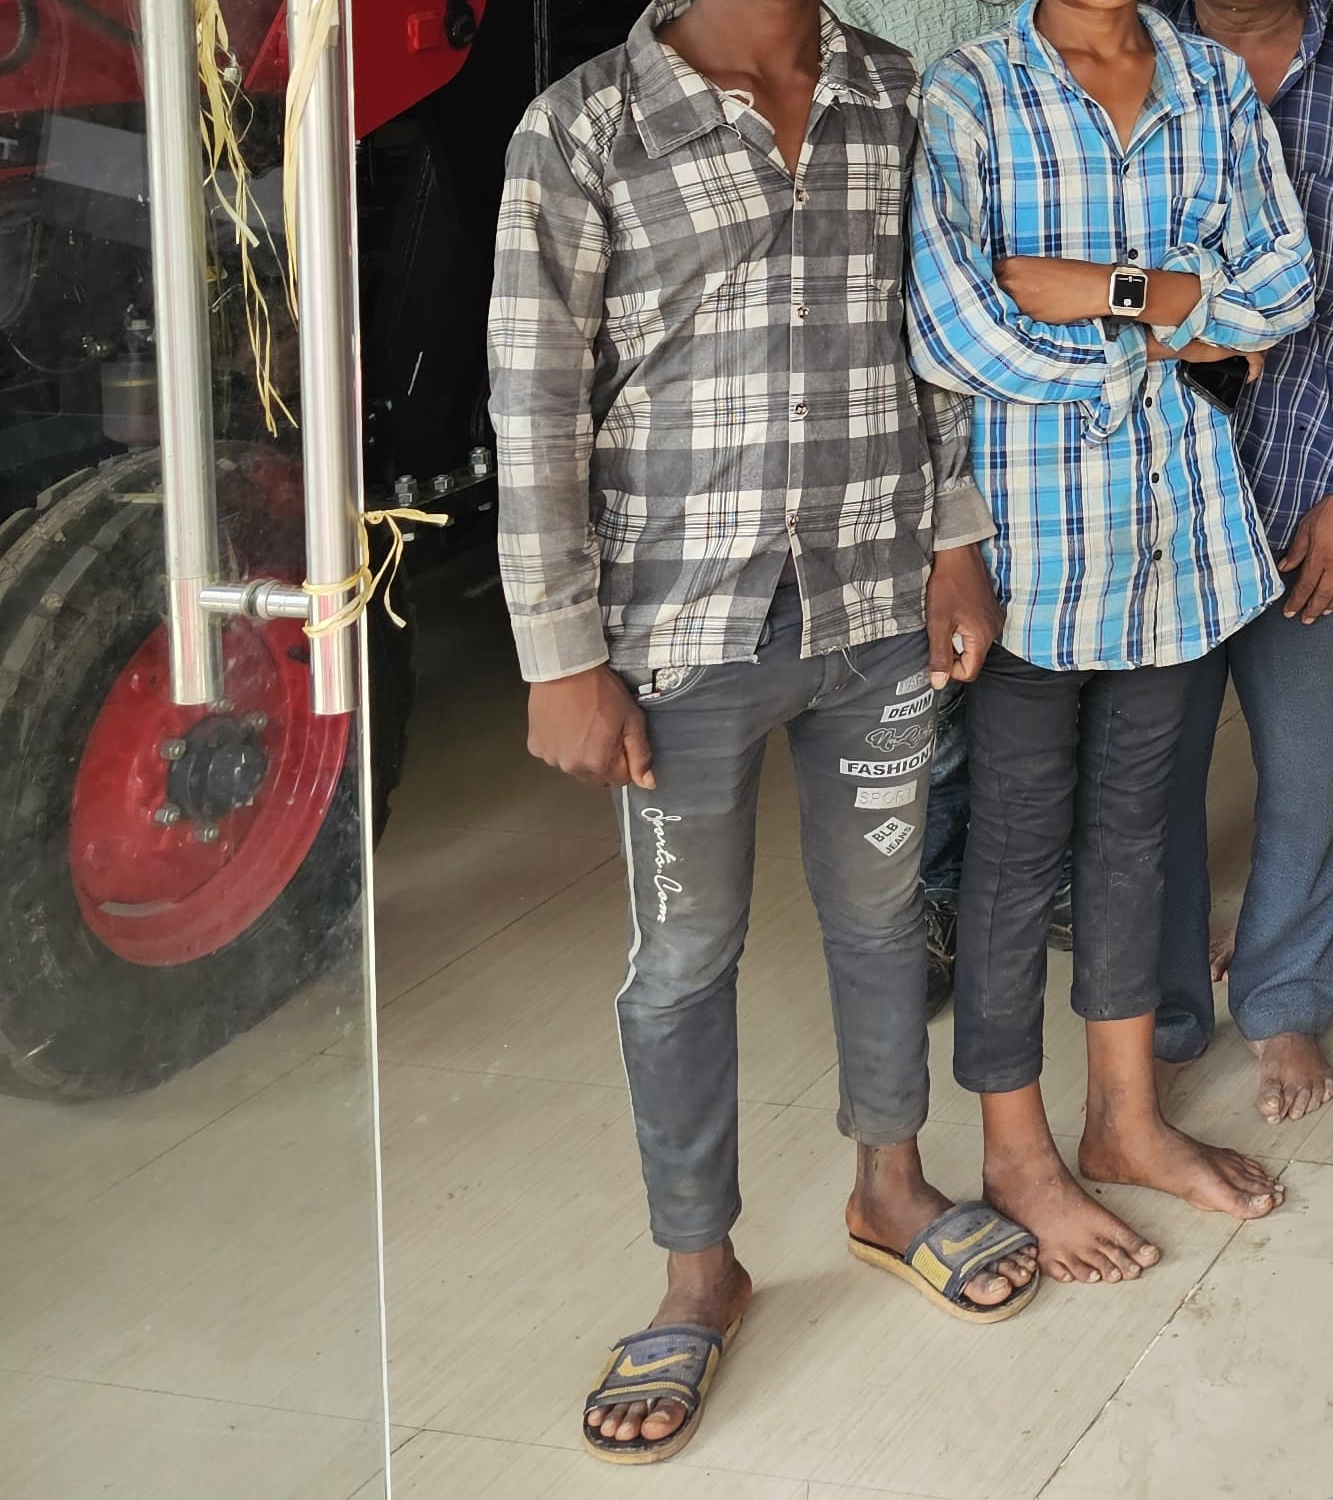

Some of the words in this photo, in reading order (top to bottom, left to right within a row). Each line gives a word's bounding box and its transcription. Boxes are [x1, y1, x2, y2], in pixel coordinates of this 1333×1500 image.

[888, 692, 932, 719] DENIM
[847, 746, 932, 774] FASHION
[858, 786, 916, 806] SPORT
[872, 821, 899, 843] BLB
[885, 825, 913, 855] JEANS
